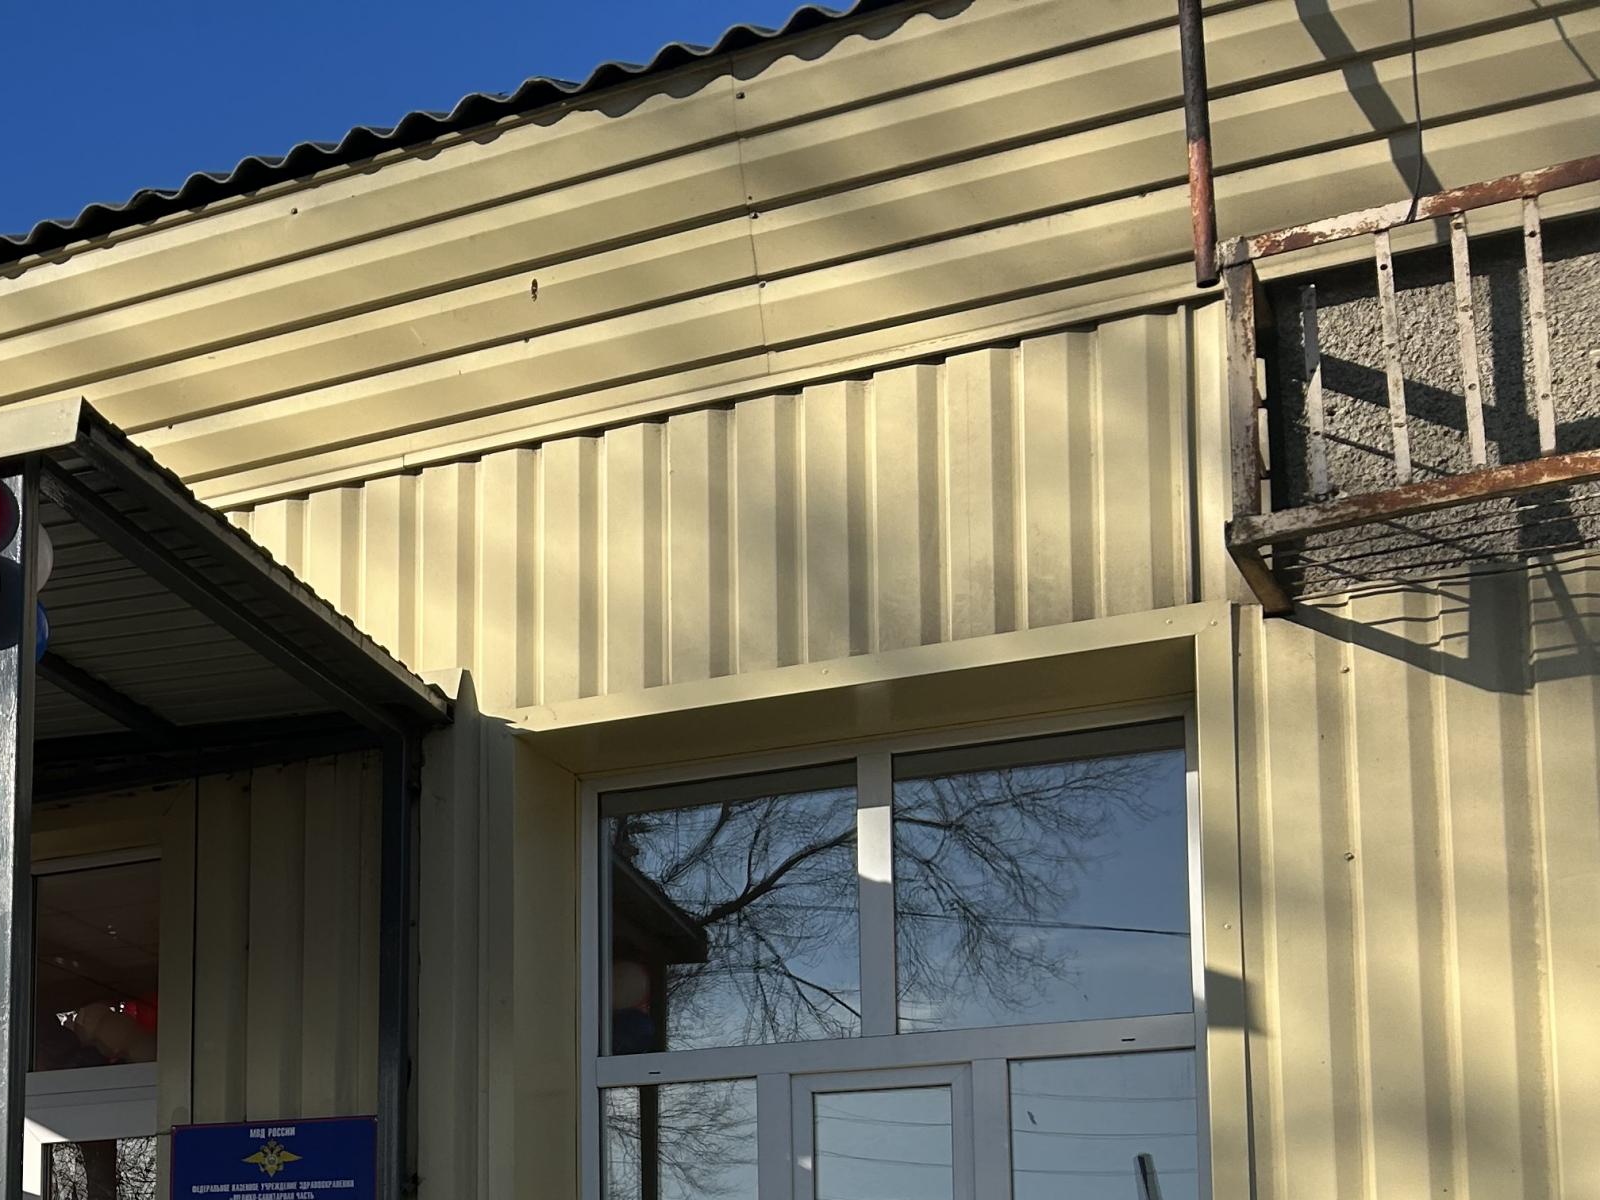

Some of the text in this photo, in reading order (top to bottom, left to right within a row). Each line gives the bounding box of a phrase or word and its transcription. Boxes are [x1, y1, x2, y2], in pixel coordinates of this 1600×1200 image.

[250, 1127, 295, 1138] МВД РОССИИ
[296, 1192, 314, 1200] ЧАСТЬ
